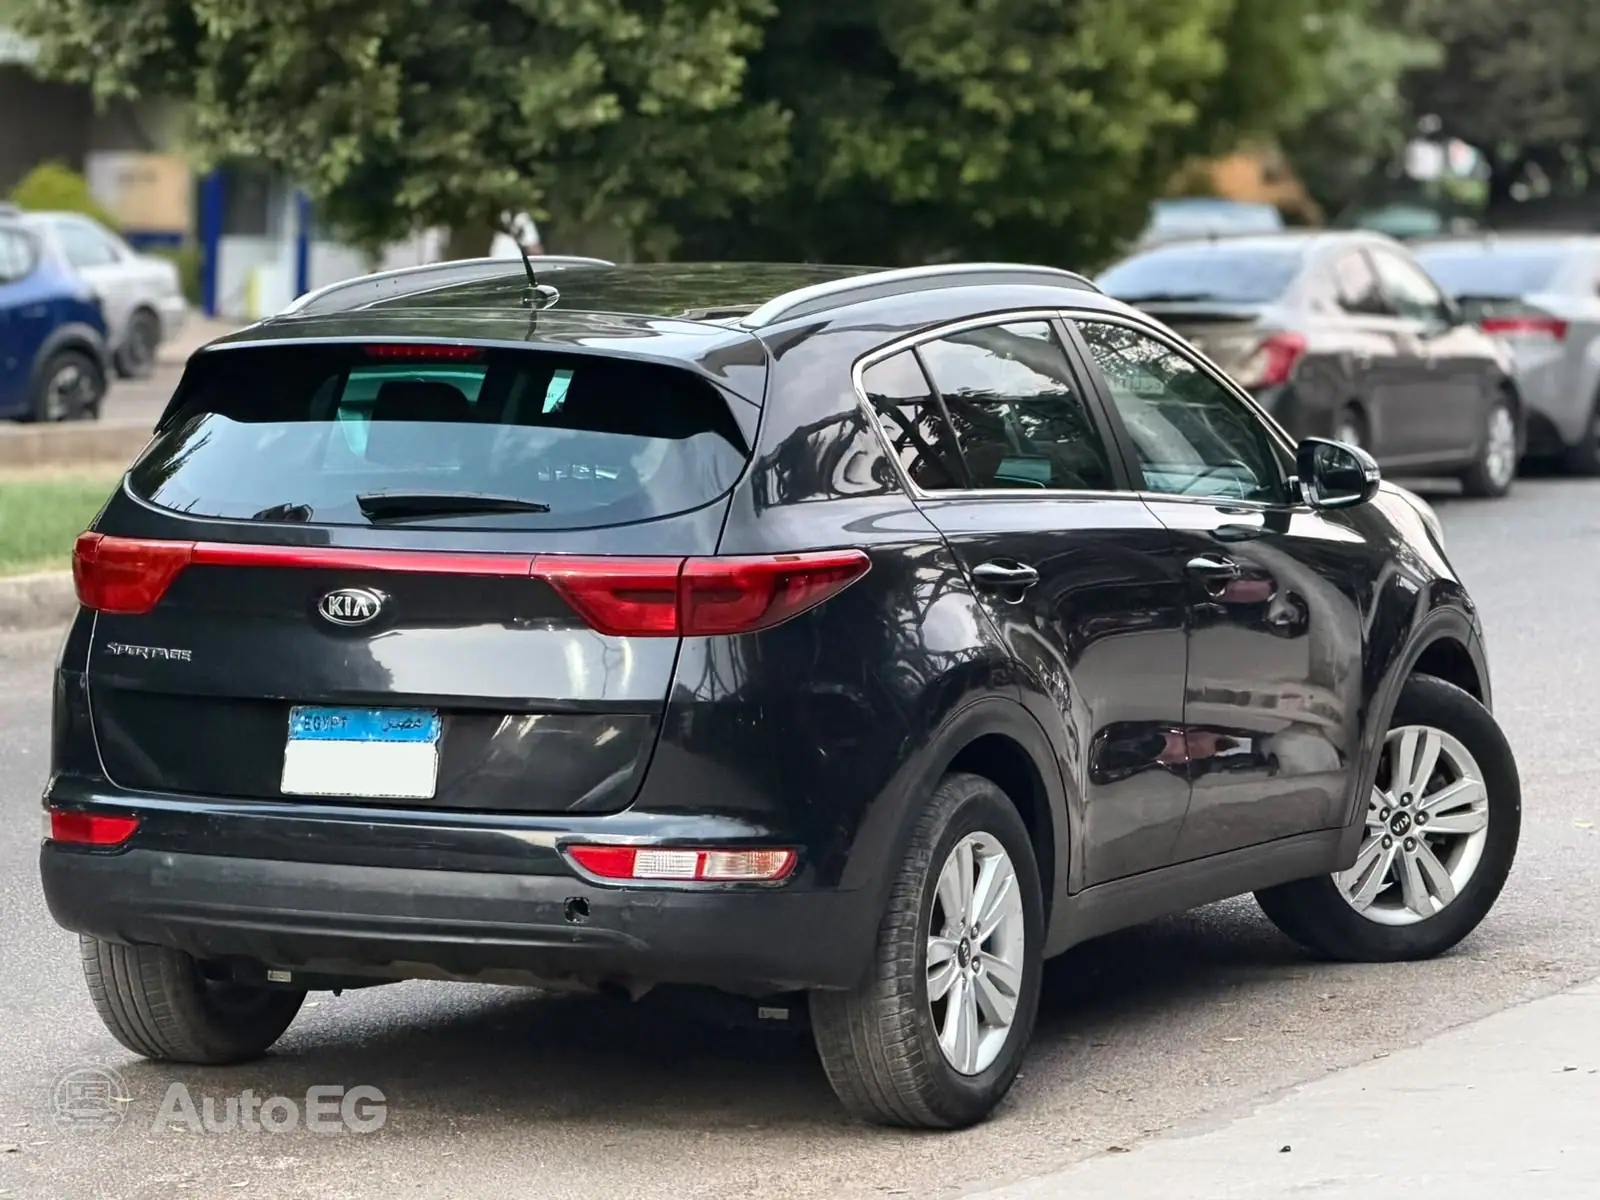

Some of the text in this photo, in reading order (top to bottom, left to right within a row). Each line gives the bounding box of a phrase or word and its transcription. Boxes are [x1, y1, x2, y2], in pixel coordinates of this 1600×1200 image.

[328, 595, 371, 617] KIA
[302, 715, 349, 732] EGYPT
[381, 715, 422, 733] مصر
[1392, 815, 1410, 832] KIA
